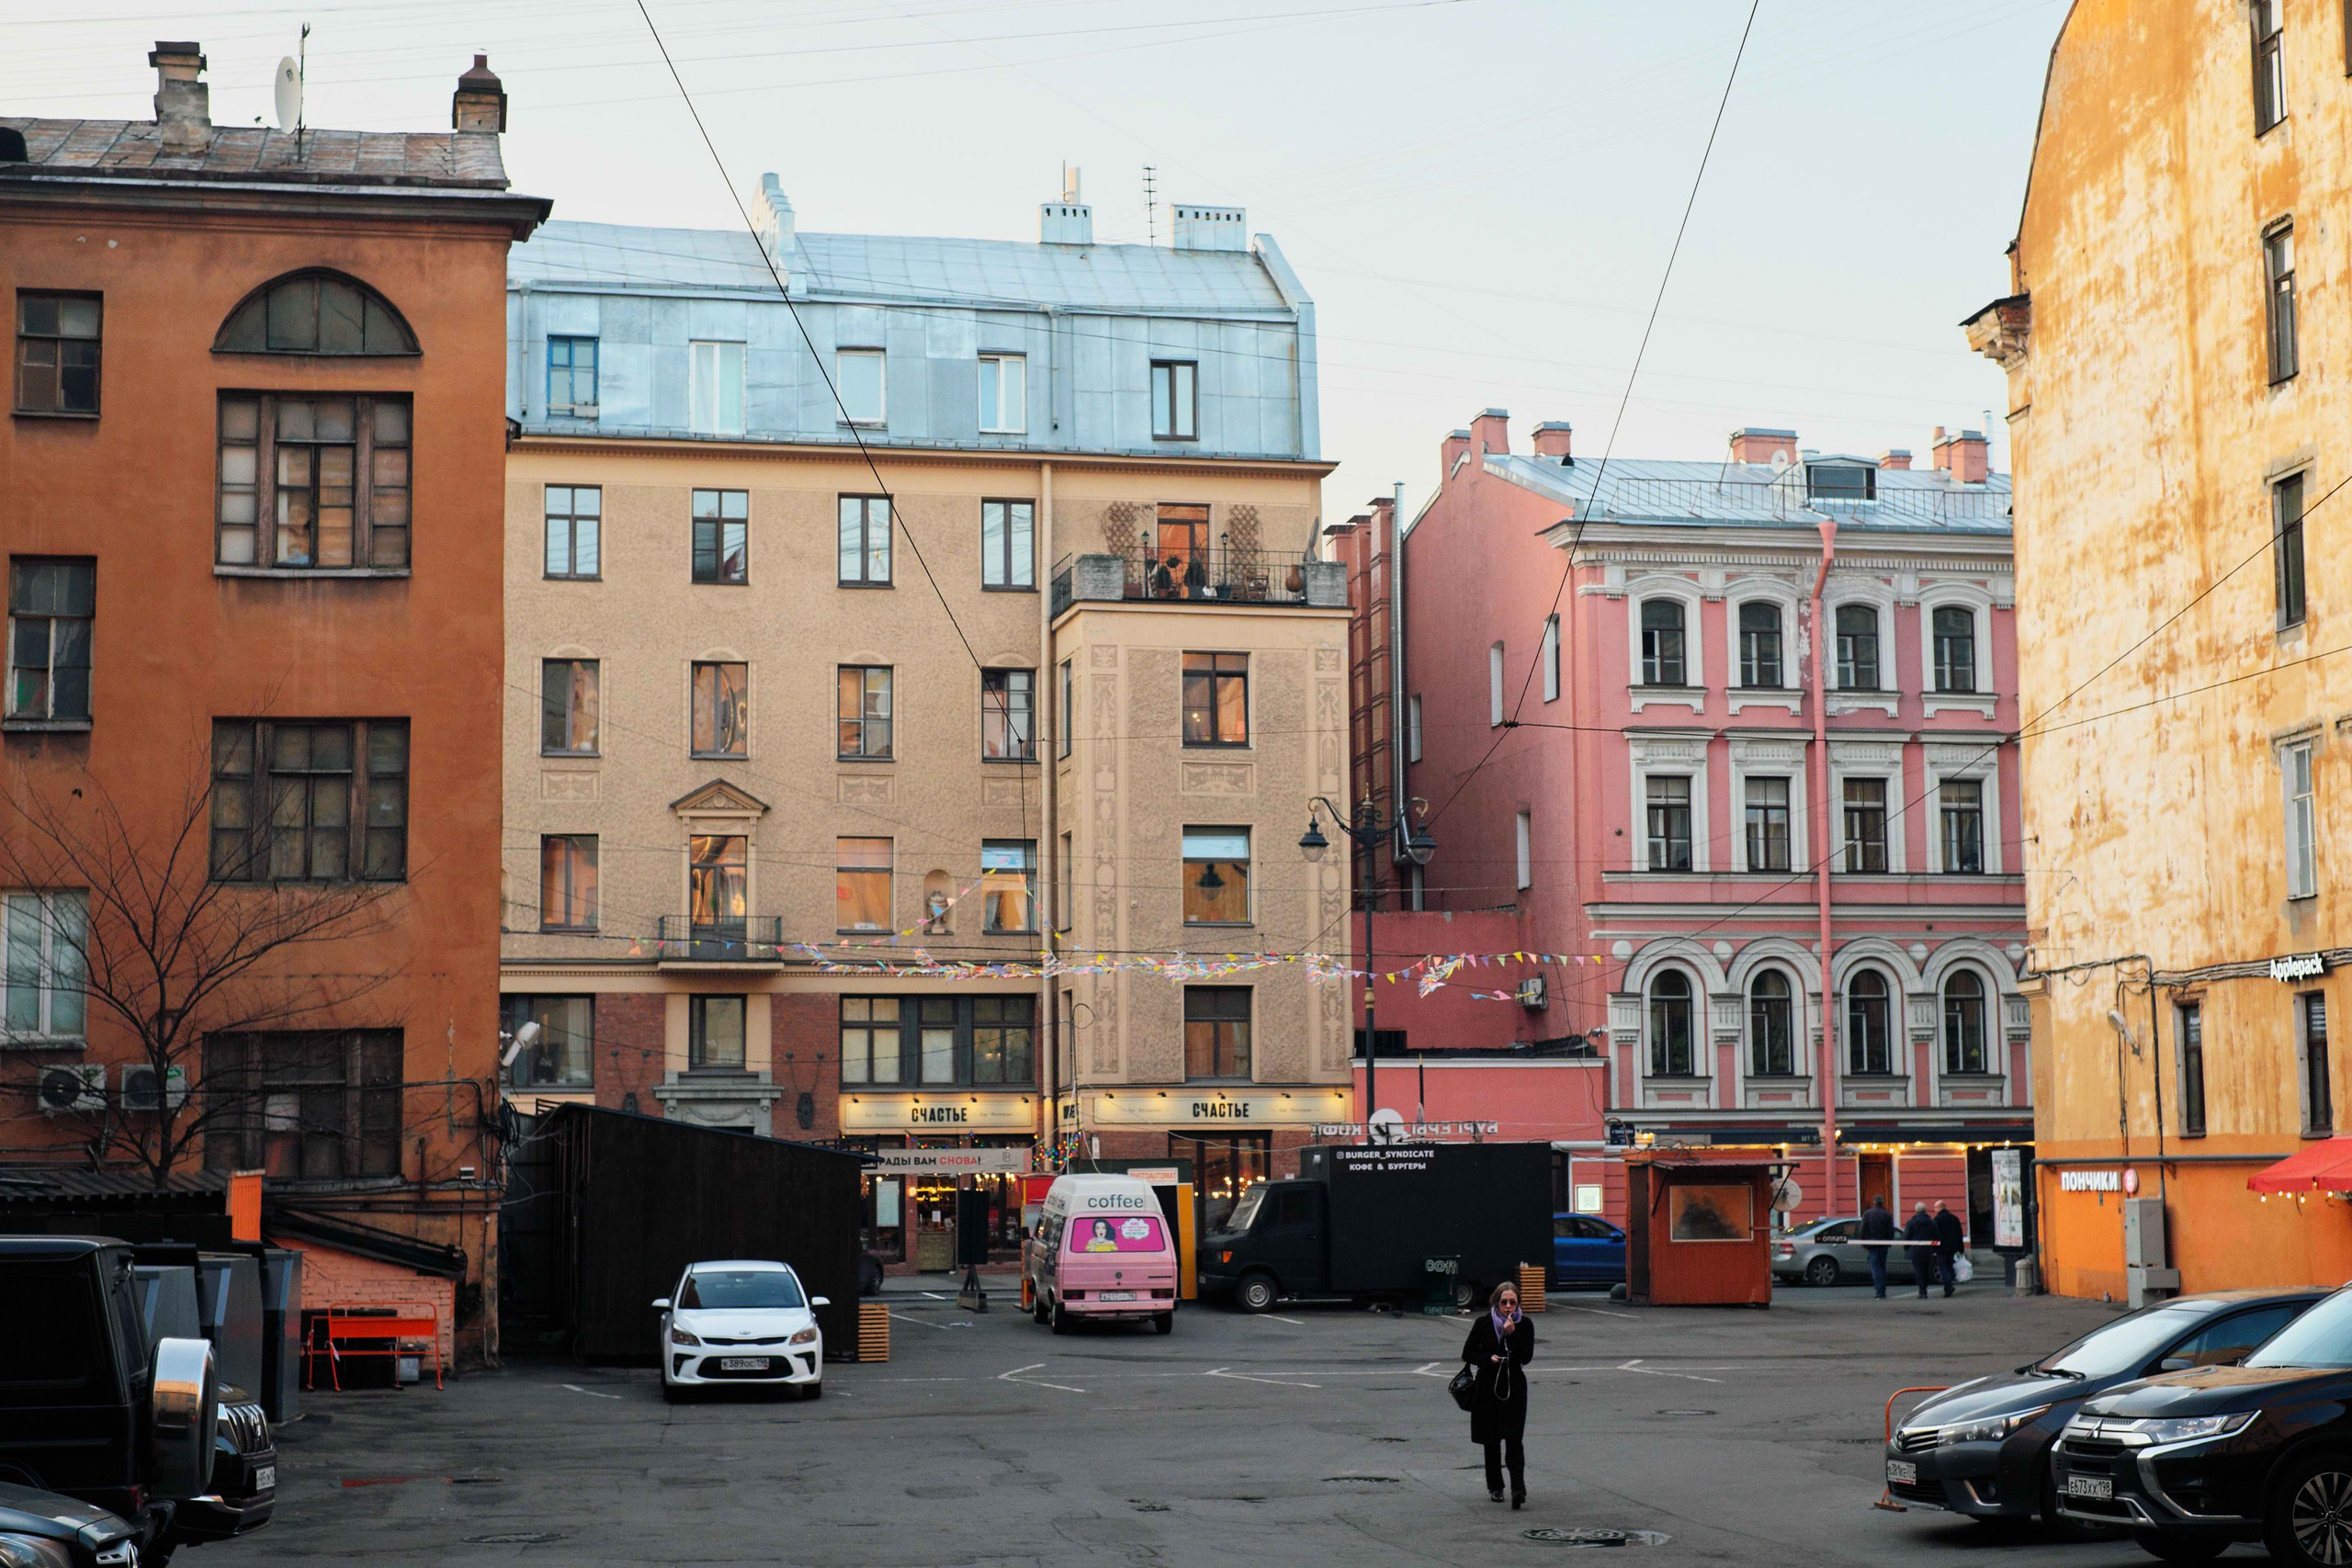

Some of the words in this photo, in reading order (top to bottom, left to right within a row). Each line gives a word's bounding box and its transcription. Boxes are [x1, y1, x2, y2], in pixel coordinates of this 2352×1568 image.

[2270, 953, 2324, 983] Applepack
[911, 1108, 967, 1122] СЧАСТЬЕ
[1193, 1102, 1250, 1118] СЧАСТЬЕ
[913, 1156, 936, 1166] ВАМ
[939, 1156, 981, 1166] СНОВА!
[1345, 1150, 1435, 1159] BURGER_SYNDICATE
[1387, 1162, 1426, 1170] БУРГЕРЫ
[2061, 1171, 2118, 1191] ПОНЧИКИ
[1088, 1194, 1144, 1208] coffee
